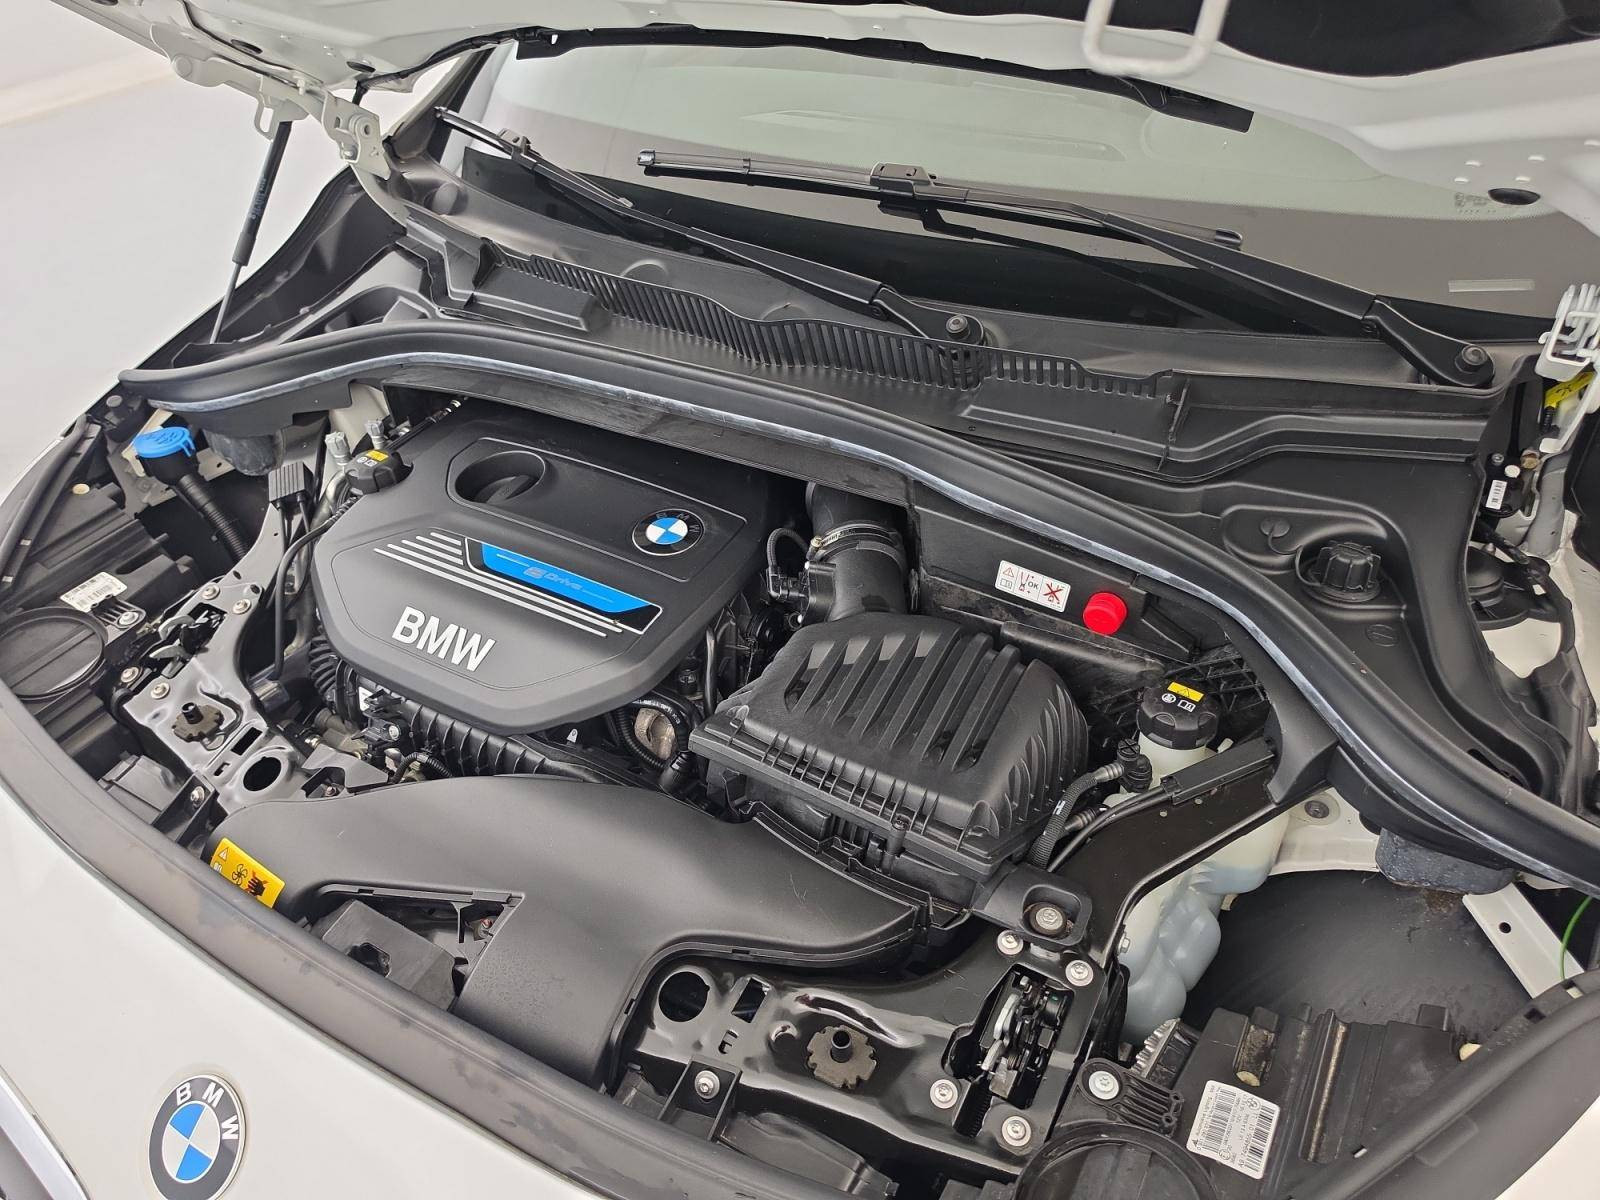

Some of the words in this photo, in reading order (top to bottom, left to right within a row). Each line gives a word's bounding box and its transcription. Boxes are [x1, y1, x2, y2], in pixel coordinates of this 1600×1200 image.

[656, 512, 700, 533] BMW
[1027, 581, 1040, 590] OK
[392, 606, 496, 672] BMW
[176, 1082, 239, 1140] BMW
